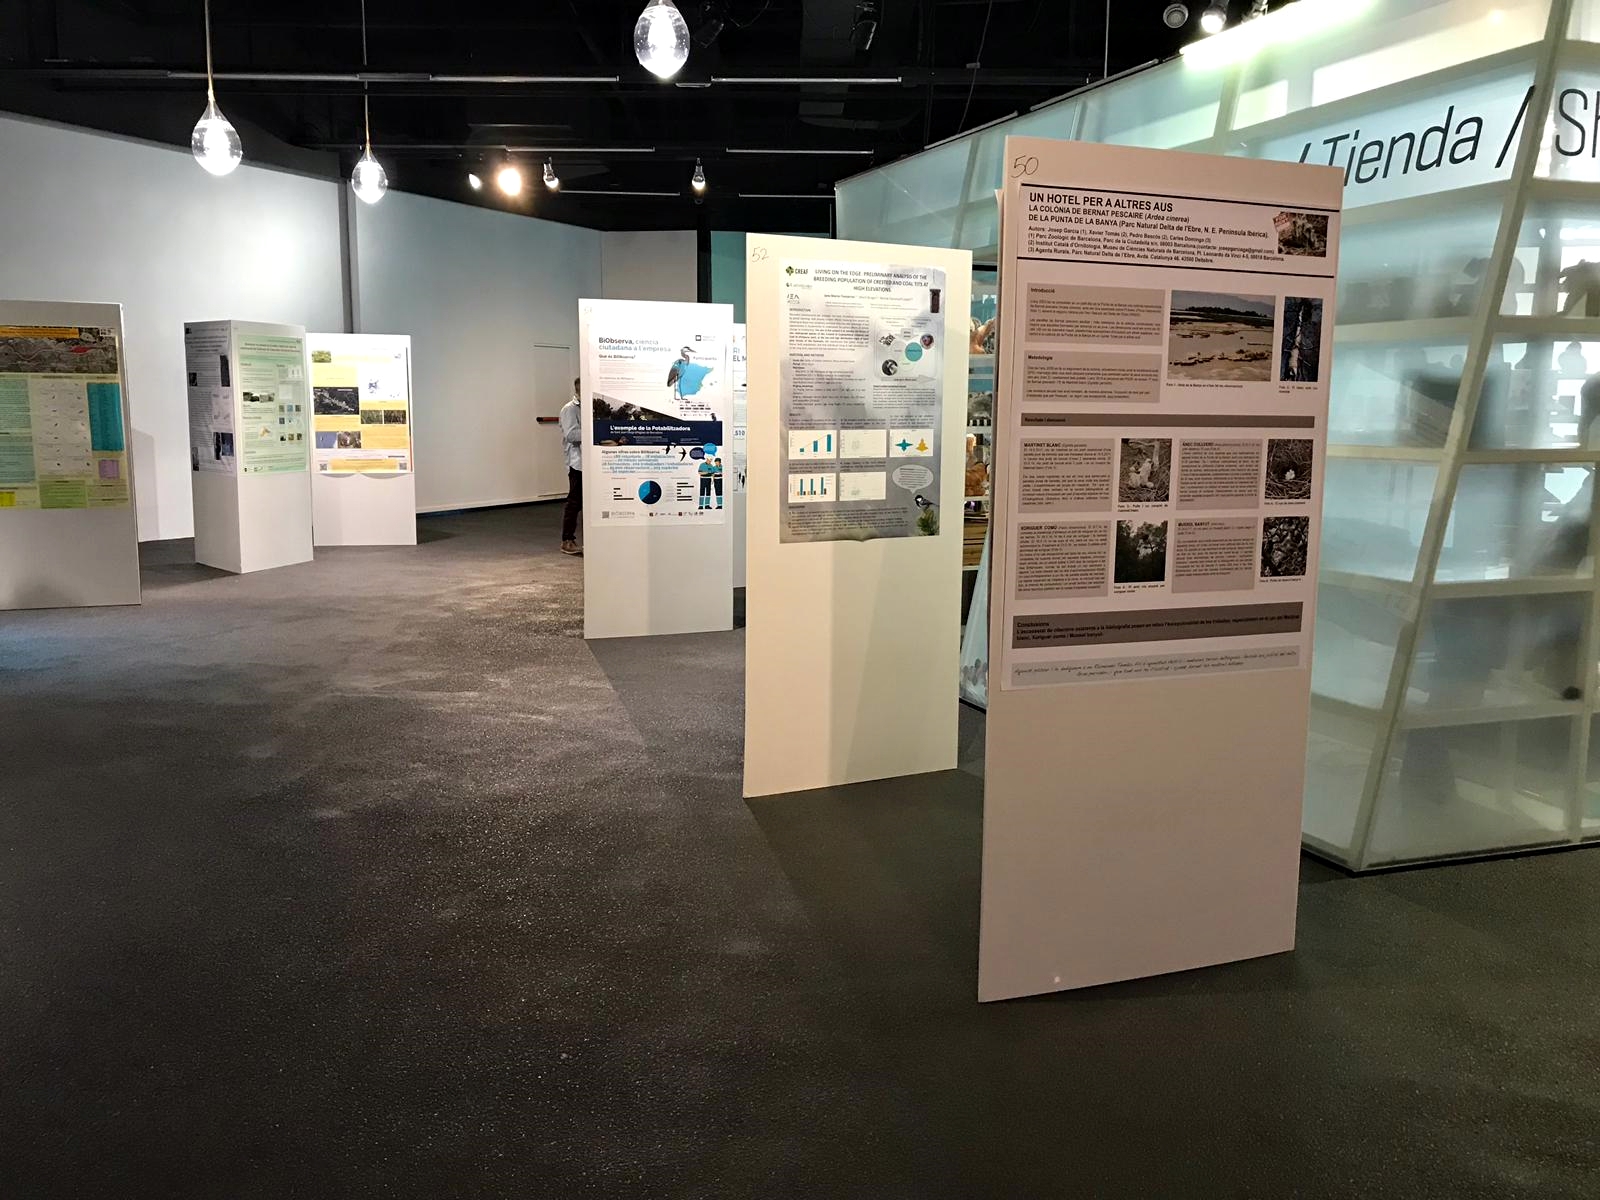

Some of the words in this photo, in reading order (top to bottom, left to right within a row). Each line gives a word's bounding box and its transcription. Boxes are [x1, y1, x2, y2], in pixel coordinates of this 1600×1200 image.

[1322, 105, 1483, 187] Tienda
[1555, 88, 1600, 158] S
[1011, 155, 1039, 178] 50
[1029, 192, 1044, 202] UN
[1047, 193, 1080, 205] HOTEL
[1083, 196, 1103, 206] PER
[1105, 198, 1112, 208] A
[1114, 199, 1152, 210] ALTRES
[1153, 202, 1173, 212] AUS
[1029, 204, 1038, 212] LA
[1083, 208, 1110, 216] BERNAT
[1111, 210, 1144, 219] PESCAIRE
[1095, 218, 1118, 226] BANYA
[1119, 220, 1135, 228] (Parc
[752, 246, 770, 262] 52
[599, 337, 634, 345] BiObserva,
